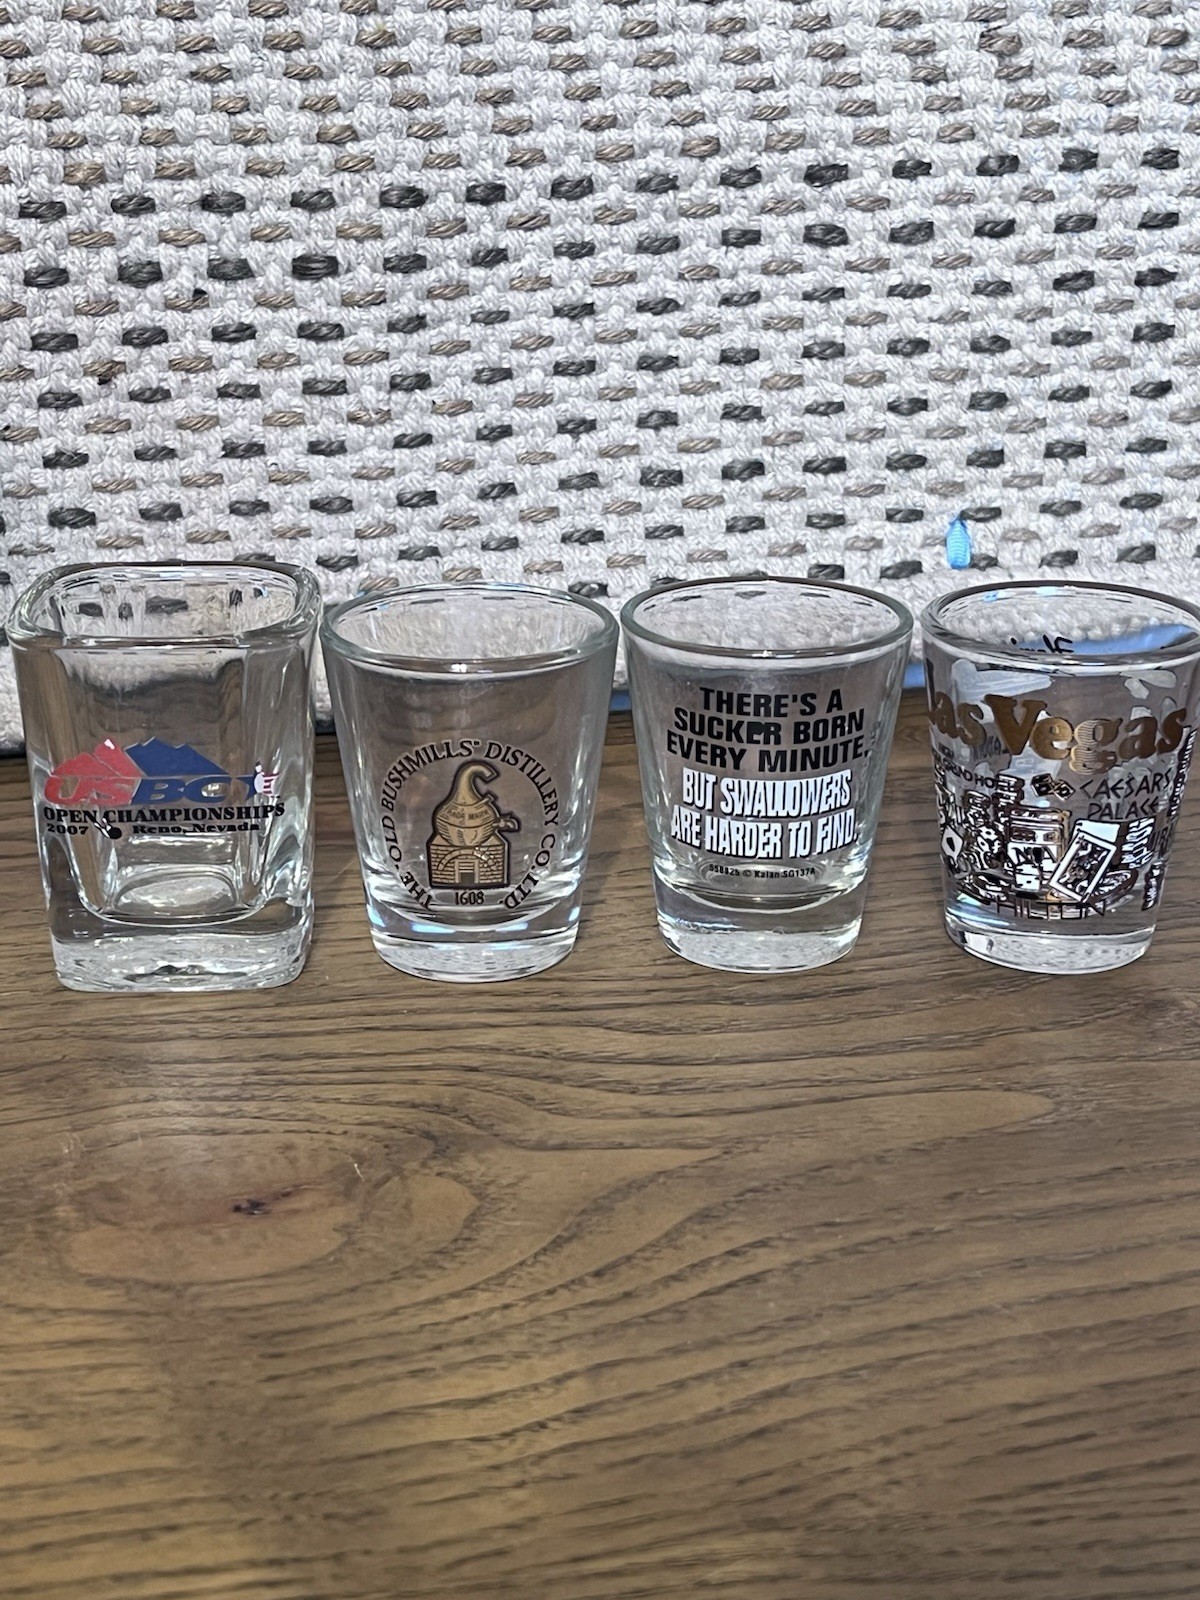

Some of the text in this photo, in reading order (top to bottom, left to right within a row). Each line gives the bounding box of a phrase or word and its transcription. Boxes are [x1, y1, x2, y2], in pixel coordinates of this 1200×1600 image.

[700, 686, 843, 717] THERE'S A
[673, 707, 864, 745] SUCKER BORN
[983, 694, 1187, 775] Vegas
[667, 729, 748, 771] EVERY
[484, 741, 559, 827] DISTILLERY
[682, 766, 853, 818] BUT SWALLOWERS
[1080, 768, 1172, 800] CAESARS
[44, 802, 285, 823] OPEN CHAMPIONSHIPS
[191, 822, 260, 833] Nevada
[1088, 799, 1159, 821] PALACE
[46, 823, 89, 835] 2007
[381, 816, 402, 863] OLD
[671, 804, 701, 848] ARE
[704, 815, 783, 859] HARDER
[788, 819, 813, 859] TO
[399, 870, 432, 910] THE
[754, 870, 780, 878] Kalan
[455, 891, 484, 905] 1608
